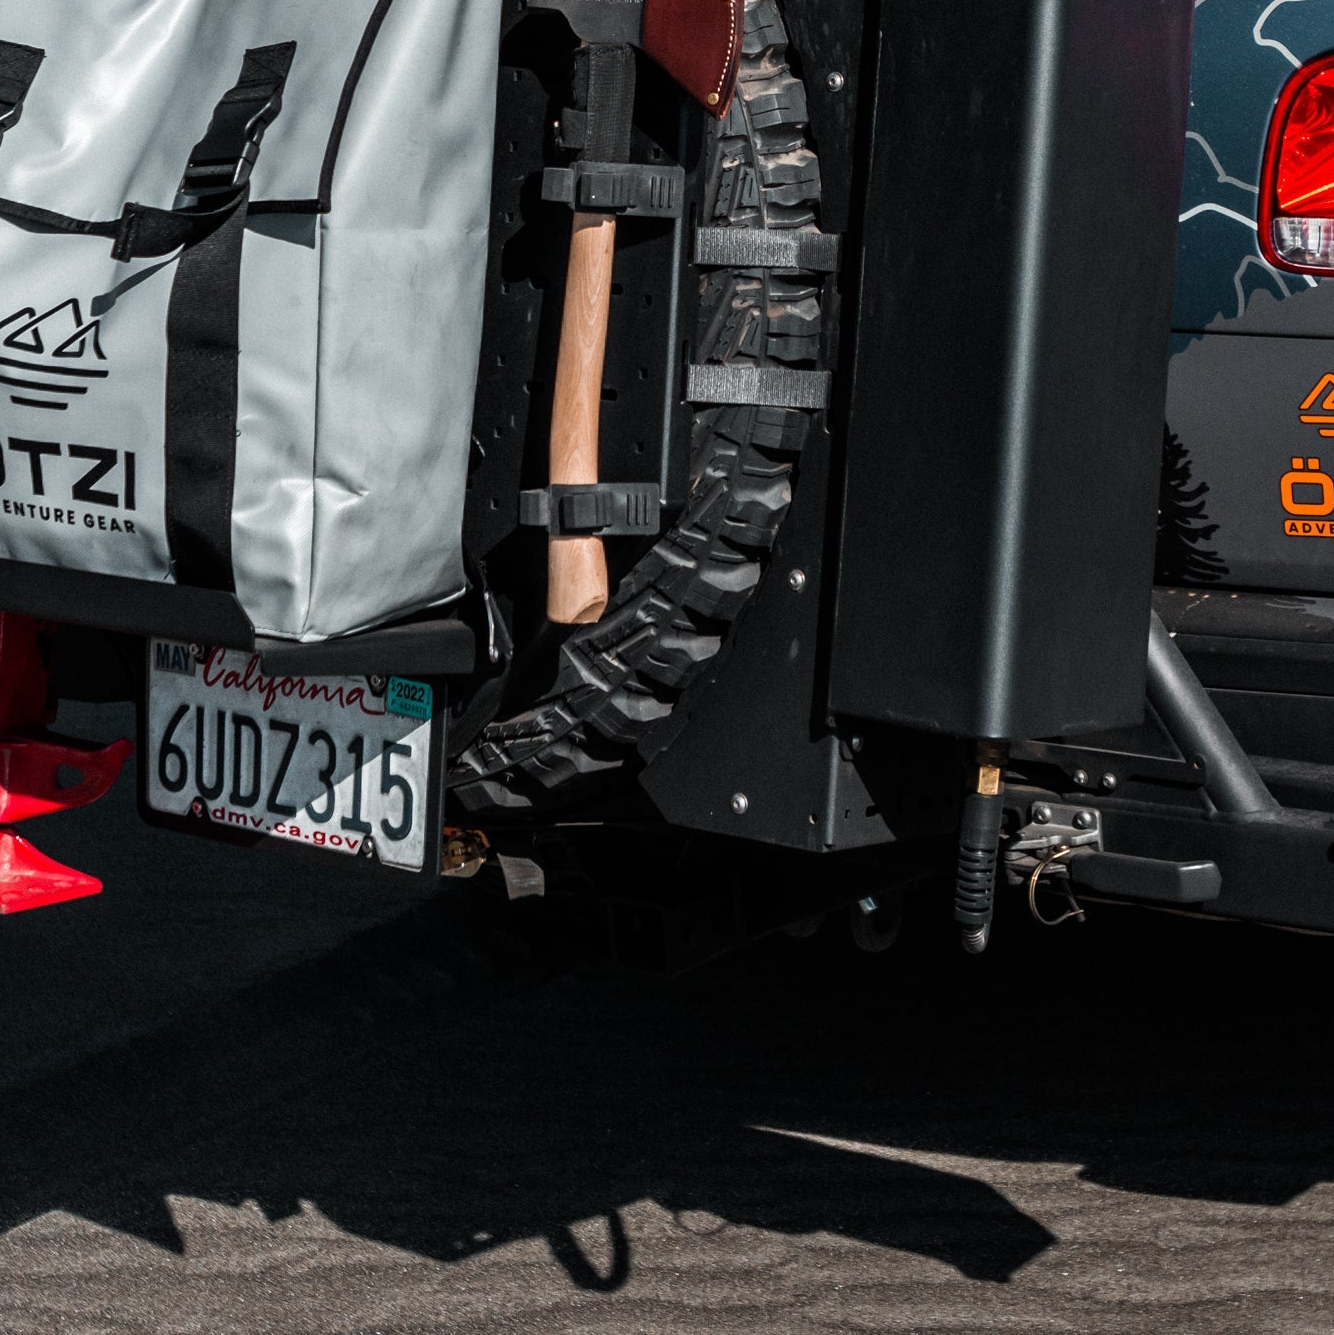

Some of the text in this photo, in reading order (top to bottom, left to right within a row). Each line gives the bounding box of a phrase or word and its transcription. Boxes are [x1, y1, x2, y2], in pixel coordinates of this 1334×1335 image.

[83, 513, 136, 534] GEAR
[155, 642, 190, 670] MAY
[202, 647, 385, 716] California
[396, 682, 425, 703] 2022
[158, 704, 414, 842] 6UDZ315
[211, 807, 359, 850] dmv.ca.gov
